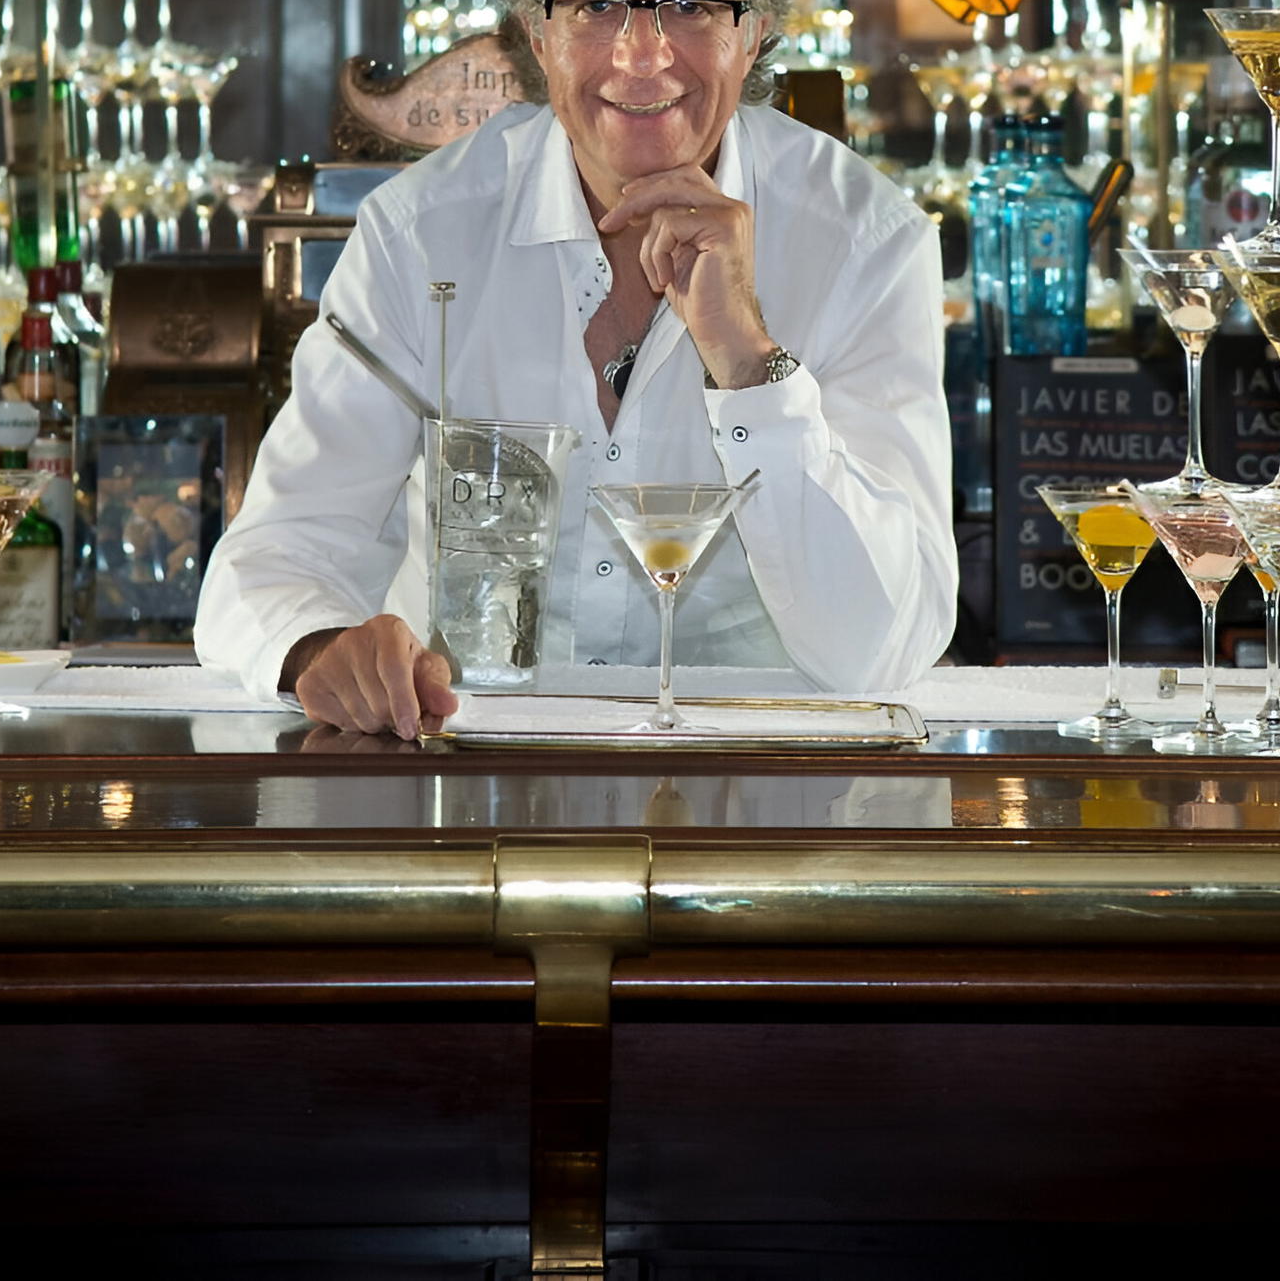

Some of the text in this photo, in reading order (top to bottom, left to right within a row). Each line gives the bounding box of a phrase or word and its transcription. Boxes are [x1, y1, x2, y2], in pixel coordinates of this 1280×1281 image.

[407, 100, 443, 128] de
[1016, 386, 1132, 416] JAVIER
[1019, 430, 1190, 460] LAS MUELAS
[1019, 562, 1103, 591] BOO
